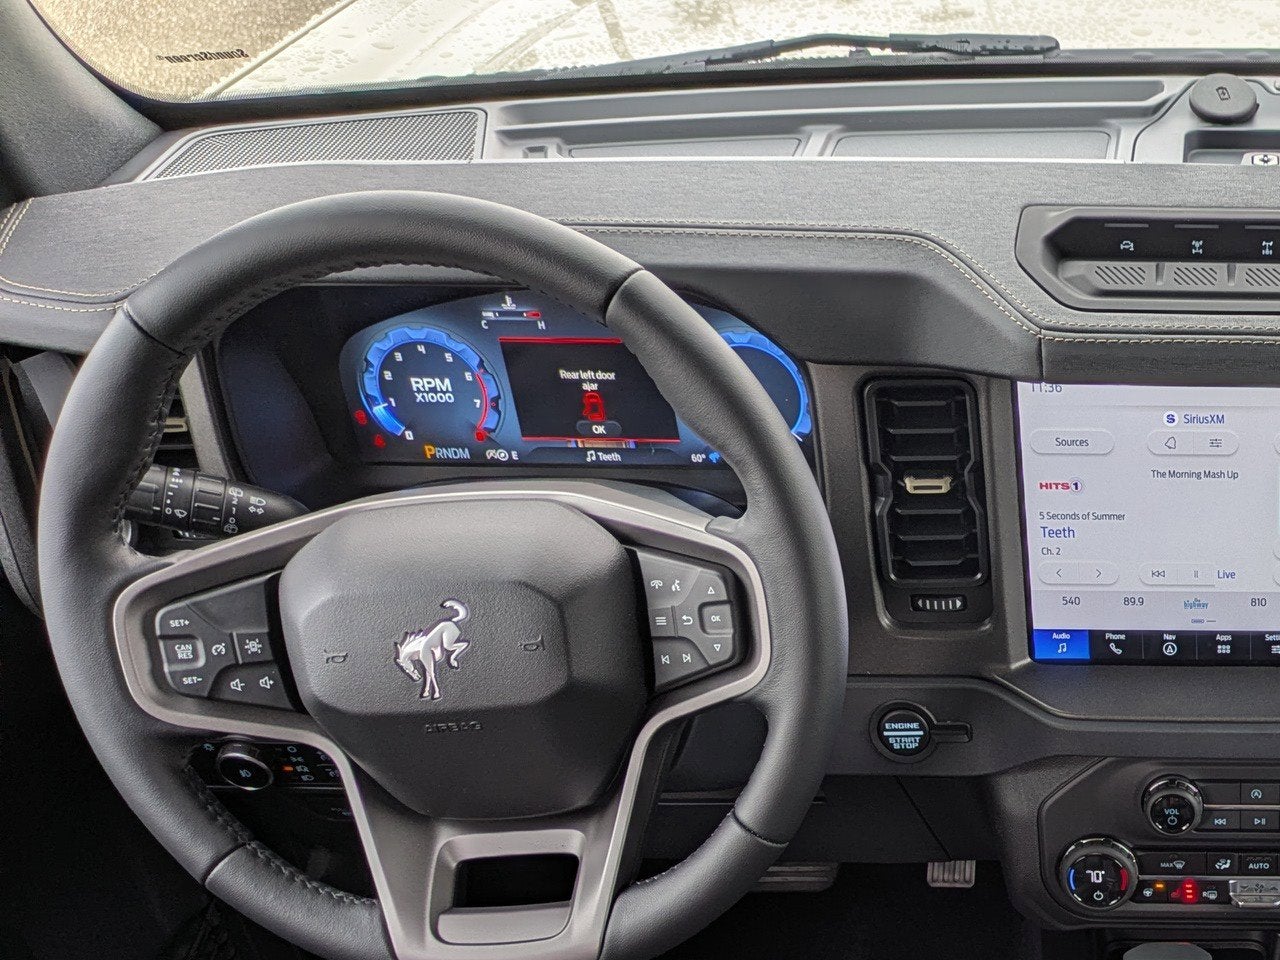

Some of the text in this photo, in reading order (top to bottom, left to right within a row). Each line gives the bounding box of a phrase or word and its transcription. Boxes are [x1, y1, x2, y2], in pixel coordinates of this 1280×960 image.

[481, 320, 489, 330] C
[537, 320, 546, 330] H
[417, 344, 426, 355] 4
[394, 352, 403, 362] 3
[444, 352, 453, 363] 5
[383, 370, 393, 381] 2
[464, 372, 473, 382] 6
[559, 369, 616, 381] Rear left door
[410, 377, 452, 392] RPM
[582, 382, 599, 392] ajar
[388, 397, 397, 407] 1
[415, 392, 455, 403] X1000
[473, 399, 482, 408] 7
[1183, 413, 1225, 425] SiriusXM
[591, 424, 607, 435] OK
[405, 430, 414, 441] 0
[1054, 437, 1089, 447] Sources
[511, 450, 520, 461] E
[597, 451, 622, 463] Teeth
[1151, 469, 1239, 481] The Morning Mash Up
[1039, 481, 1070, 491] HITS
[1039, 511, 1126, 521] 5 Seconds of Summer
[1040, 526, 1076, 539] Teeth
[1041, 547, 1062, 556] Ch. 2
[1217, 569, 1236, 580] Live
[1062, 596, 1081, 606] 540
[1123, 596, 1145, 606] 89.9
[1250, 598, 1267, 607] 810
[169, 619, 190, 628] SET+
[1052, 632, 1071, 640] Audio
[1105, 632, 1126, 640] Phone
[1163, 633, 1176, 641] Nav
[1215, 633, 1232, 642] Apps
[177, 652, 194, 660] RES
